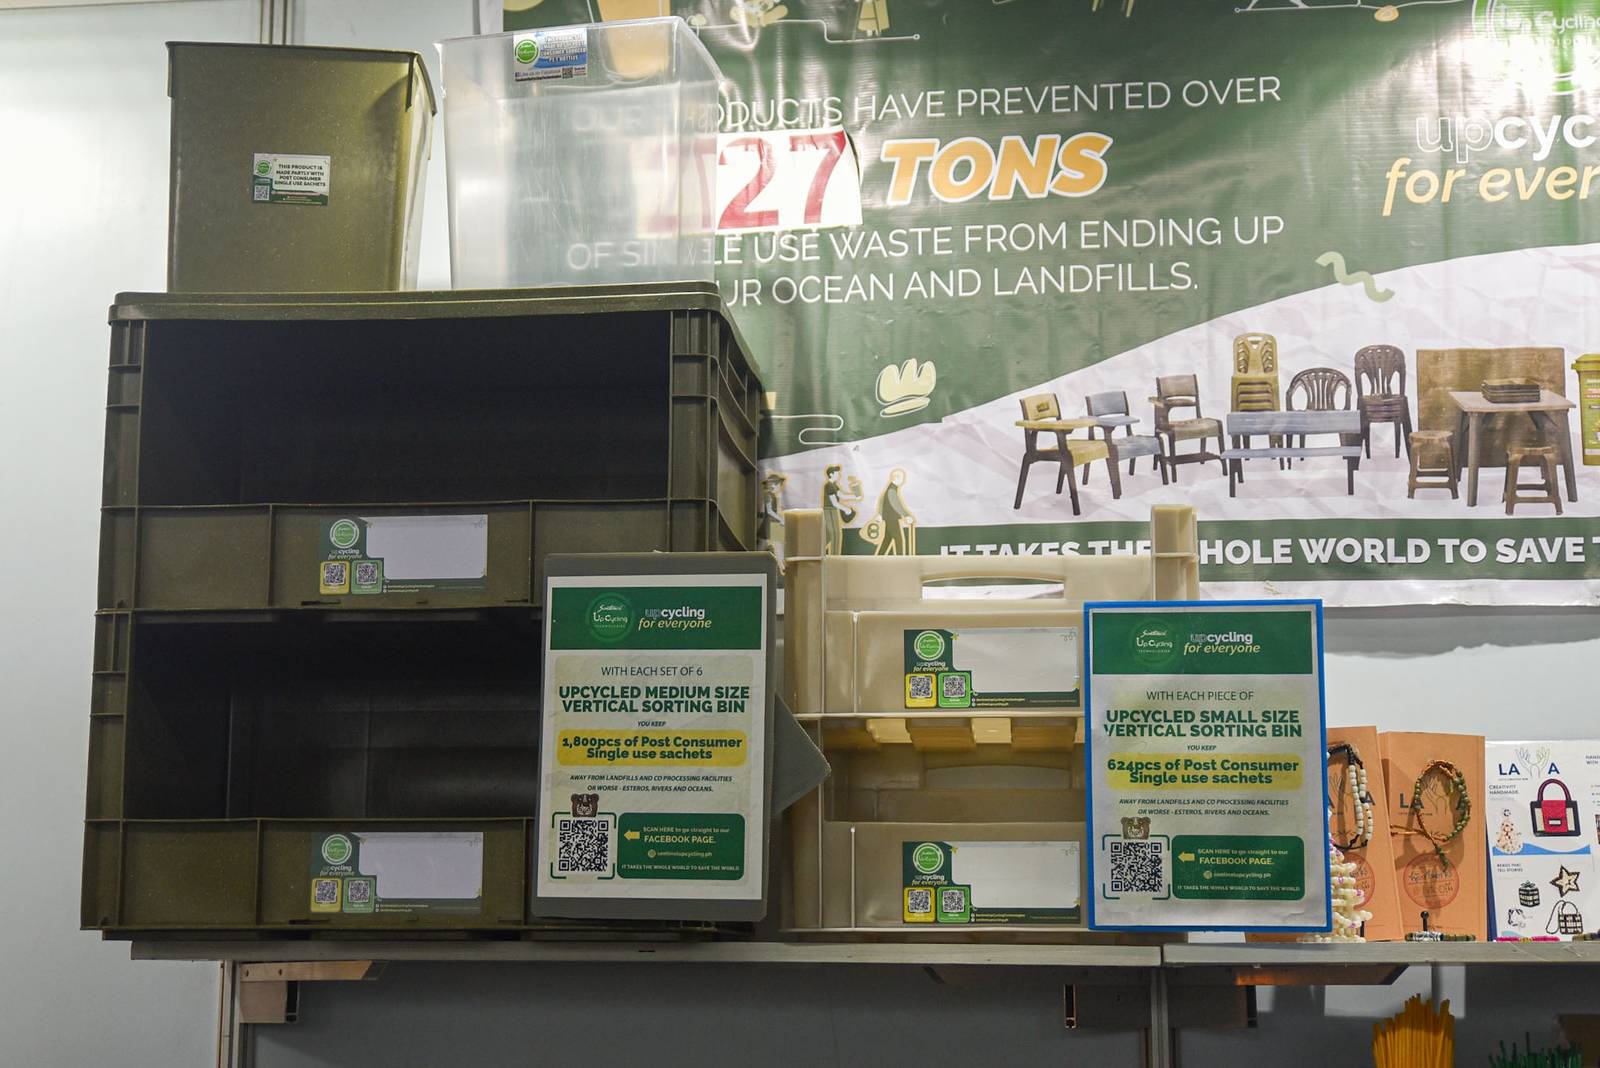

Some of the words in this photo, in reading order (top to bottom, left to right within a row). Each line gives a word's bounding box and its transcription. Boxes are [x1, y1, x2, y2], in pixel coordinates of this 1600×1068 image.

[853, 90, 946, 121] HAVE
[958, 81, 1170, 116] PREVENTED
[1182, 76, 1281, 108] OVER
[880, 132, 1114, 205] TONS
[1382, 157, 1466, 216] for
[567, 241, 614, 270] OF
[754, 233, 821, 263] USE
[829, 227, 953, 261] WASTE
[965, 221, 1067, 253] FROM
[1080, 217, 1222, 250] ENDING
[1233, 215, 1284, 245] UP
[771, 272, 894, 304] OCEAN
[904, 269, 982, 300] AND
[994, 262, 1198, 297] LANDFILLS.
[1200, 538, 1293, 565] HOLE
[1298, 537, 1431, 564] WORLD
[1438, 538, 1487, 564] TO
[1496, 537, 1586, 563] SAVE
[644, 606, 705, 619] upcycling
[638, 618, 657, 631] for
[658, 620, 712, 631] everyone
[1190, 632, 1253, 644] upcycling
[1184, 643, 1202, 655] for
[1204, 644, 1260, 656] everyone
[601, 667, 628, 676] WITH
[630, 667, 657, 676] EACH
[660, 667, 678, 676] SET
[680, 667, 695, 676] OF
[696, 667, 703, 676] 6
[559, 686, 641, 699] UPCYCLED
[646, 686, 710, 699] MEDIUM
[714, 686, 750, 699] SIZE
[1147, 691, 1174, 700] WITH
[1177, 691, 1204, 700] EACH
[1208, 691, 1237, 700] PIECE
[1239, 691, 1254, 700] OF
[562, 700, 639, 712] VERTICAL
[642, 700, 713, 712] SORTING
[717, 700, 745, 712] BIN
[1106, 710, 1196, 723] UPCYCLED
[1200, 710, 1258, 723] SMALL
[1262, 710, 1299, 723] SIZE
[1104, 724, 1186, 737] VERTICAL
[1190, 724, 1267, 737] SORTING
[1271, 724, 1302, 737] BIN
[562, 736, 621, 749] 1,800pcs
[624, 736, 638, 747] of
[641, 736, 670, 747] Post
[673, 736, 742, 748] Consumer
[586, 748, 630, 761] Single
[632, 750, 656, 759] use
[659, 748, 712, 759] sachets
[1107, 759, 1161, 773] 624pcs
[1165, 758, 1180, 770] of
[1184, 759, 1217, 771] Post
[1220, 759, 1299, 772] Consumer
[1130, 772, 1178, 786] Single
[1181, 774, 1209, 784] use
[1212, 772, 1273, 784] sachets
